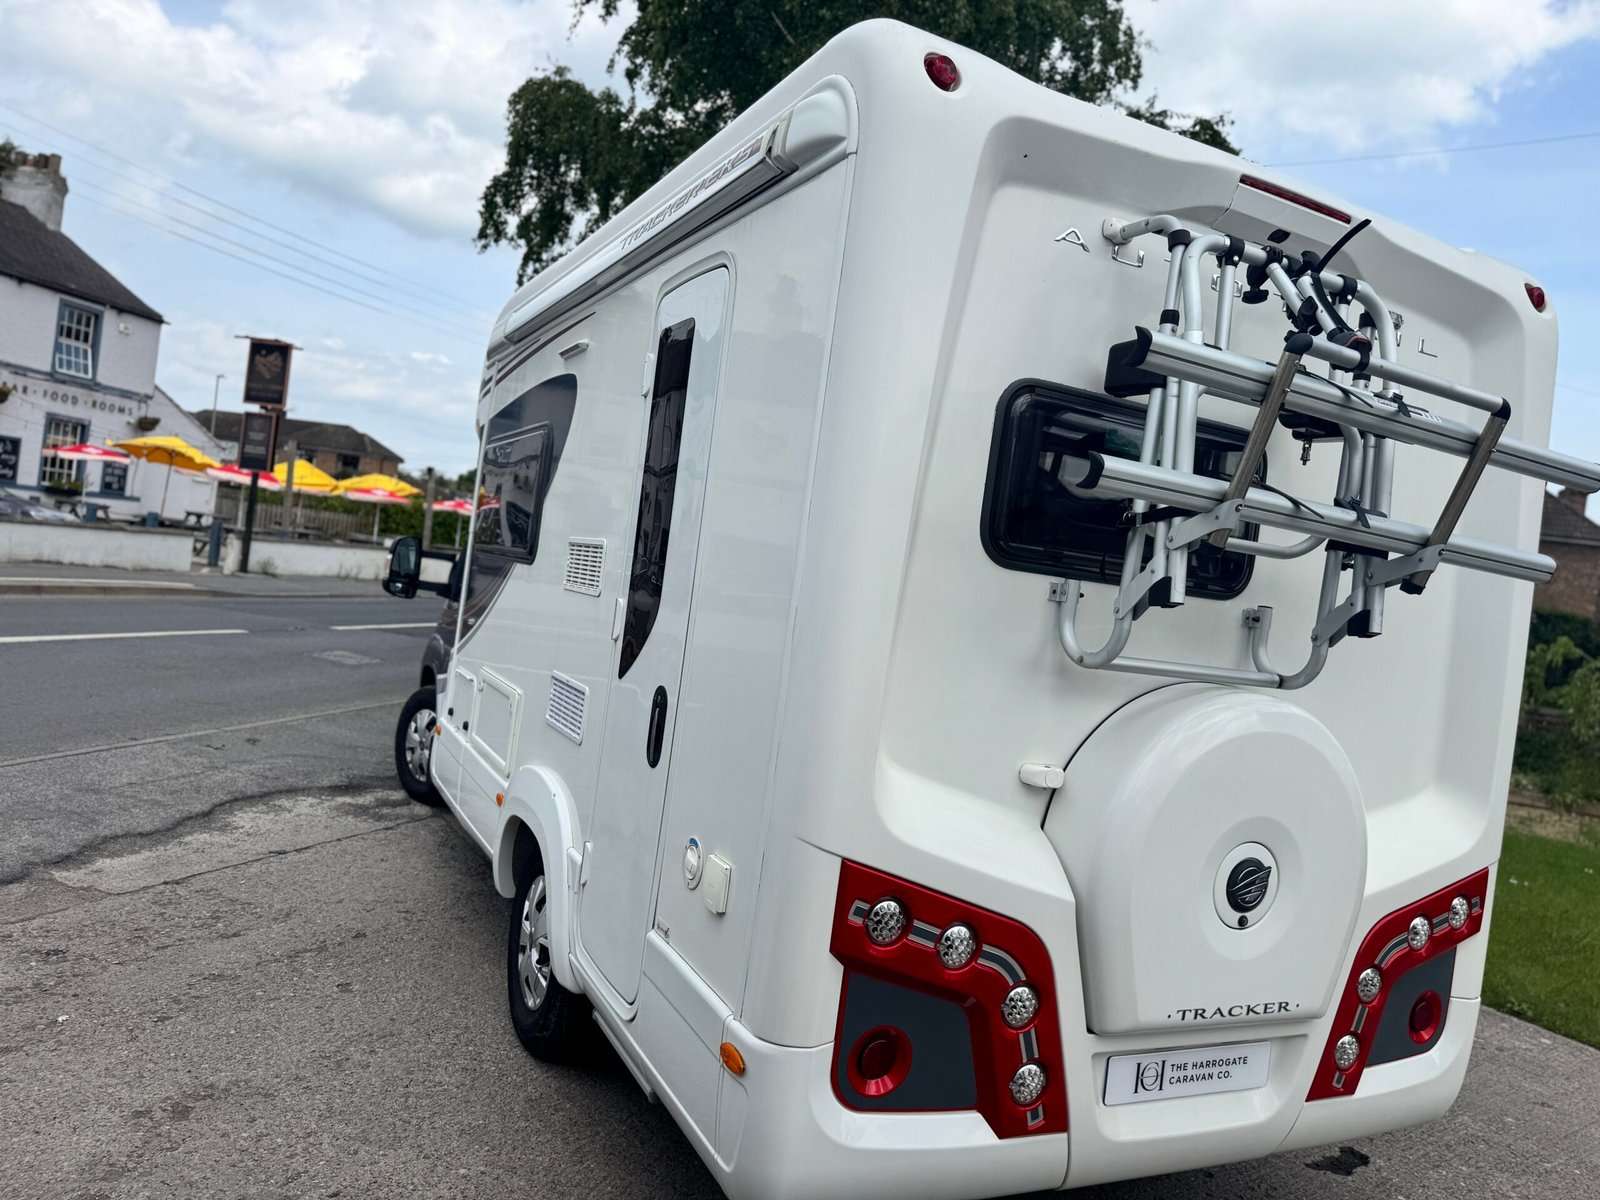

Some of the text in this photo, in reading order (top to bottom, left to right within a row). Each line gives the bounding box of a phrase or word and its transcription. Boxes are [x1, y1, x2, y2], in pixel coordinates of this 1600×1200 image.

[43, 389, 79, 406] FOOD
[91, 400, 133, 416] ROOMS
[1171, 1056, 1248, 1073] THE HARROGATE
[1169, 1070, 1233, 1085] CARAVAN CO.
